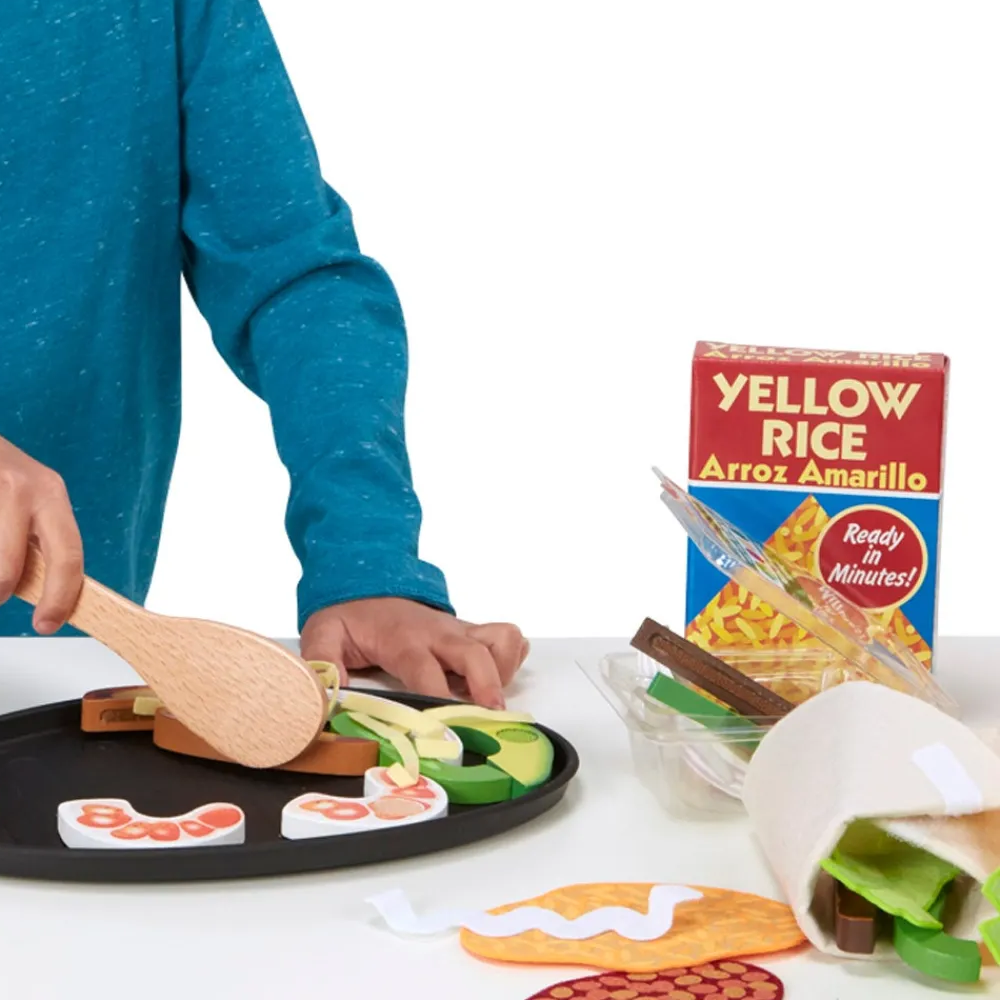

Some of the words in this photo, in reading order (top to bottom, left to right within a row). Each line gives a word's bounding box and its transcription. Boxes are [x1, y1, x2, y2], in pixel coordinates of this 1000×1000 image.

[704, 350, 791, 362] Arroz
[803, 355, 932, 369] Amarillo
[705, 341, 847, 359] YELLOW
[859, 351, 931, 361] RICE
[712, 372, 922, 421] YELLOW
[761, 418, 867, 462] RICE
[698, 453, 788, 483] Arroz
[798, 458, 928, 491] Amarillo
[842, 522, 905, 552] Ready
[861, 543, 883, 566] in
[827, 565, 918, 589] Minutes!
